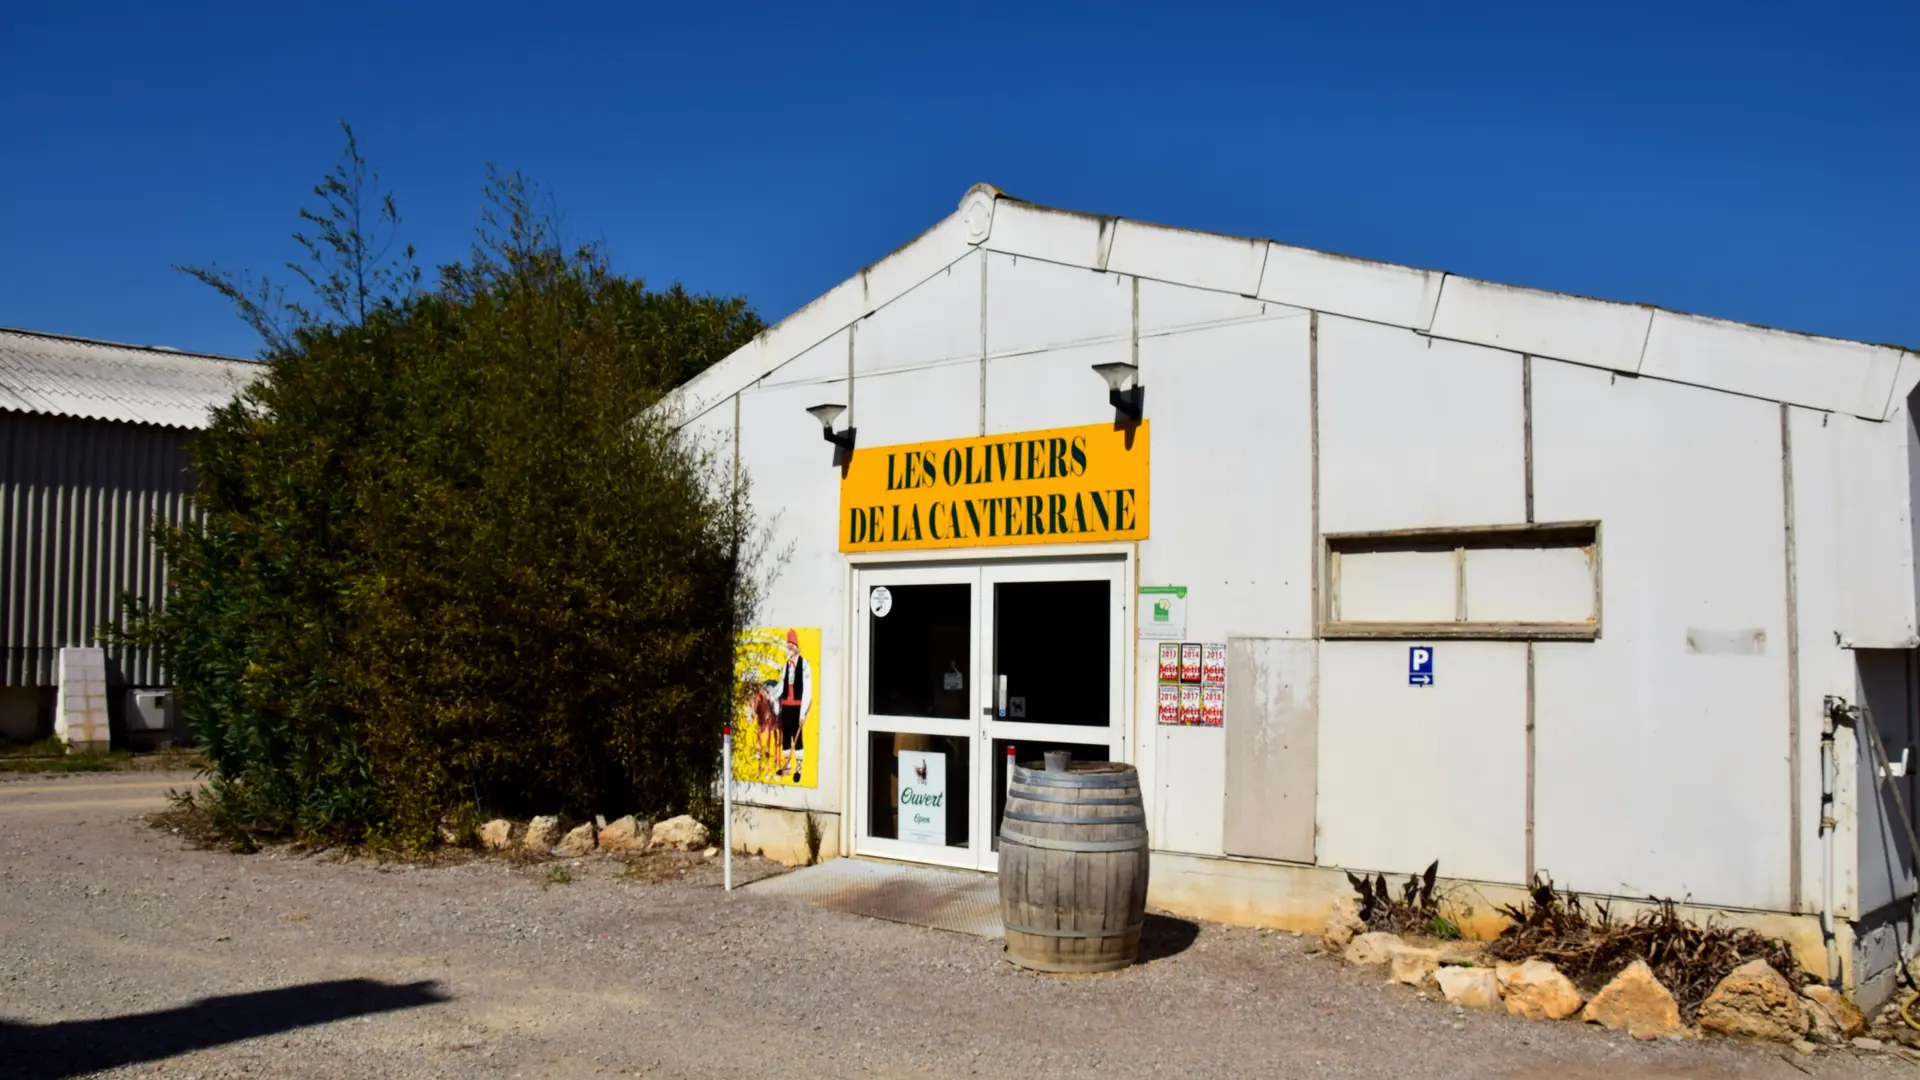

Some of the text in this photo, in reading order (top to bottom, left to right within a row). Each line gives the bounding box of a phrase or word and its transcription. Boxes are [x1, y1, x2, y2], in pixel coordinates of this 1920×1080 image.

[886, 435, 1087, 491] LES OLIVIERS
[849, 488, 1136, 544] DE LA CANTERRANE
[1183, 650, 1199, 659] 2014
[1206, 651, 1223, 660] 2015
[1413, 649, 1430, 671] P
[1160, 692, 1178, 701] 2016
[1183, 692, 1199, 701] 2017
[1205, 692, 1222, 701] 2018
[901, 786, 944, 808] Ouvert
[913, 813, 931, 825] Open
